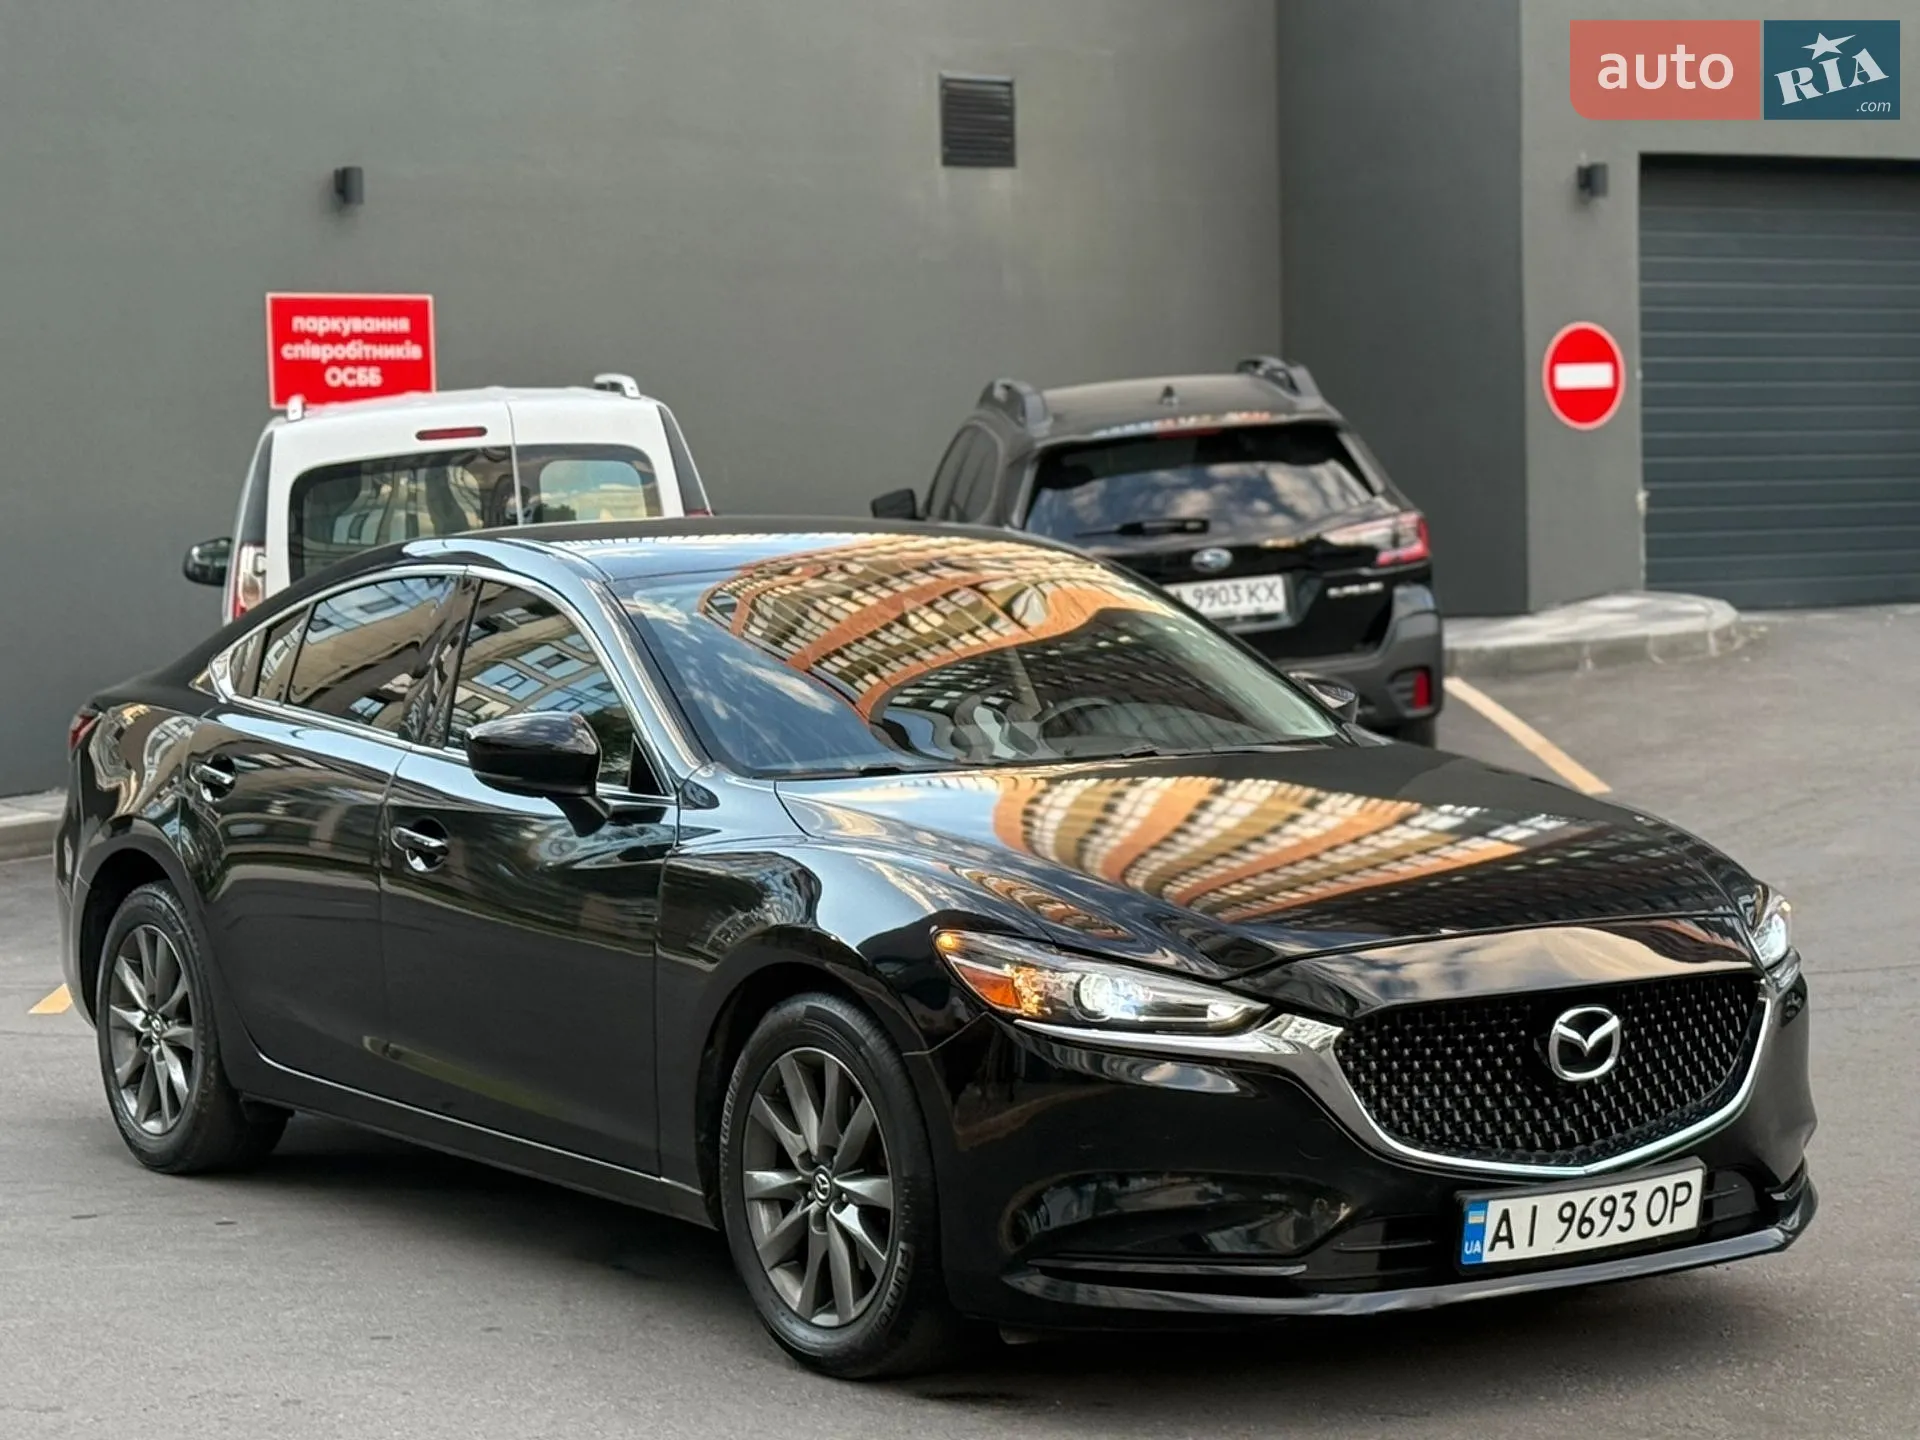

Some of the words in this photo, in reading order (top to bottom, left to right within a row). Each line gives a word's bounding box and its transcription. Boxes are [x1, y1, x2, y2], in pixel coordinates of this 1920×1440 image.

[291, 315, 411, 337] паркування
[281, 338, 423, 364] співробітників
[324, 366, 383, 388] ОСББ
[1192, 585, 1242, 609] 9903
[1246, 581, 1281, 604] KX
[1488, 1204, 1538, 1252] AI
[1556, 1190, 1638, 1244] 9693
[1646, 1180, 1693, 1228] OP
[1464, 1242, 1482, 1255] UA
